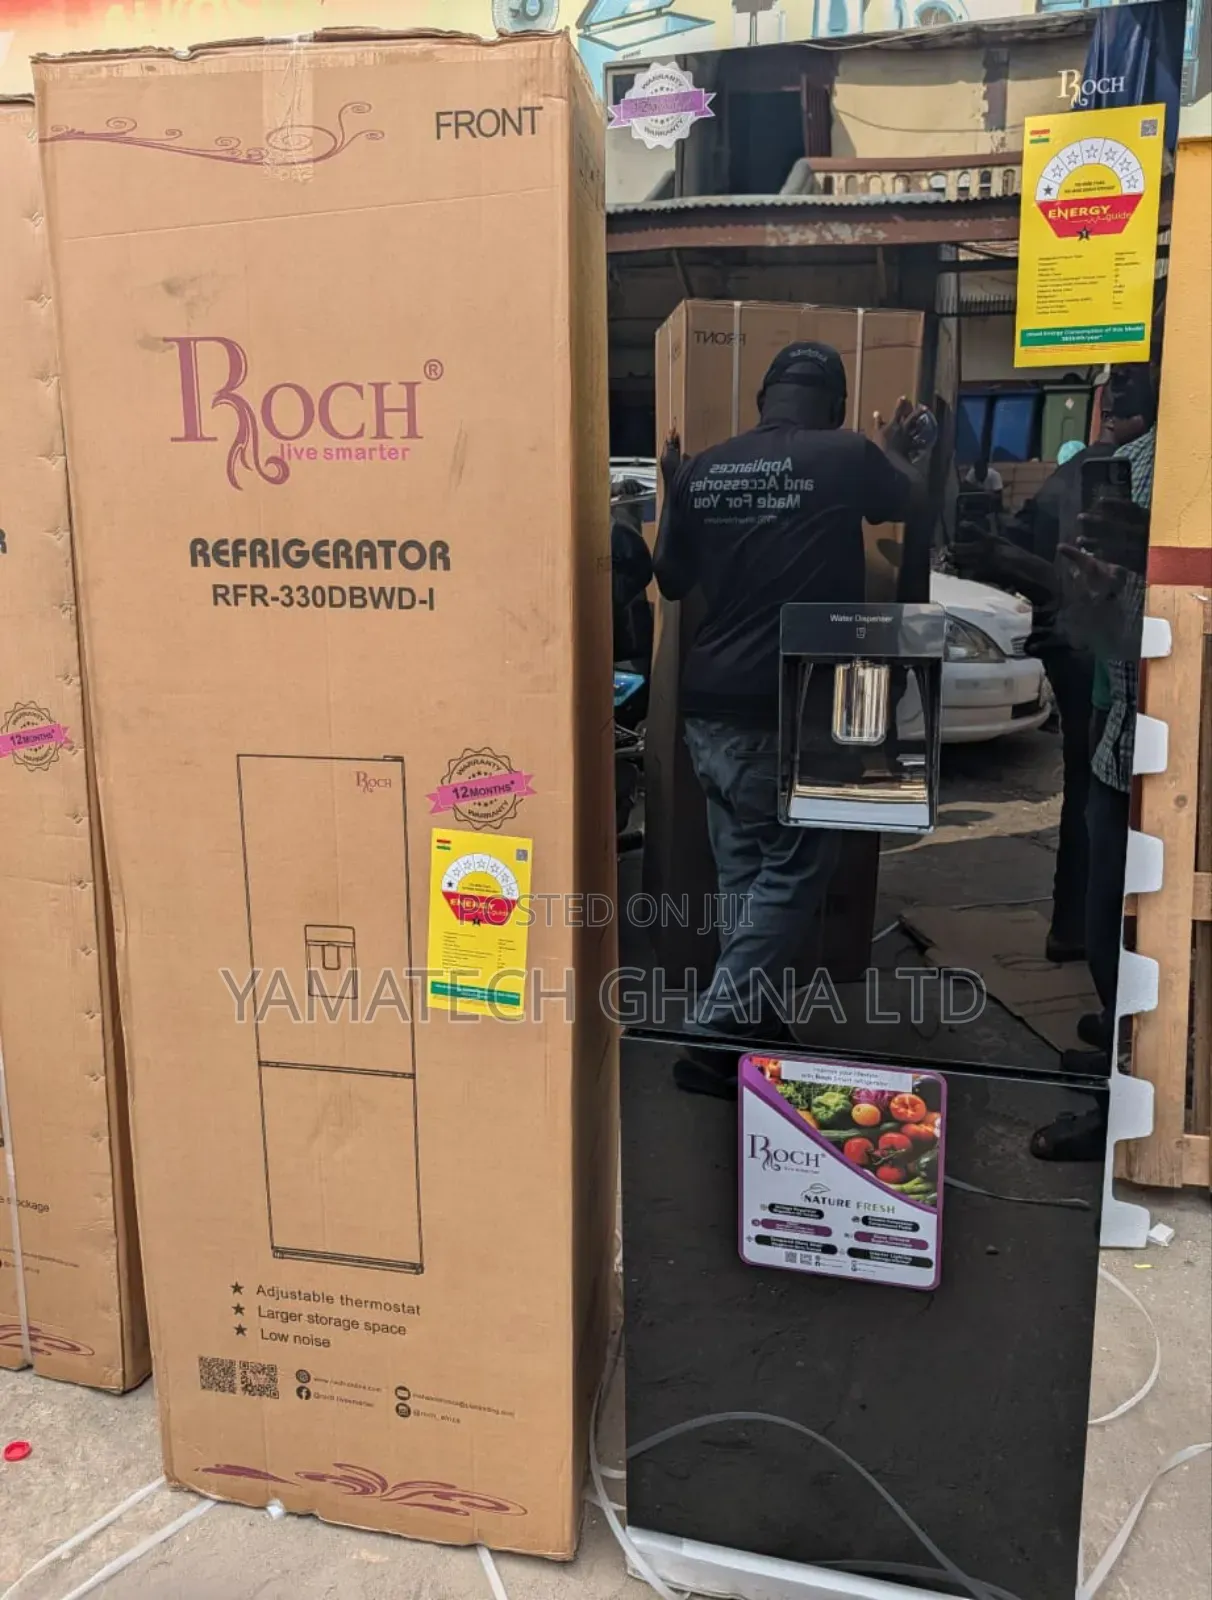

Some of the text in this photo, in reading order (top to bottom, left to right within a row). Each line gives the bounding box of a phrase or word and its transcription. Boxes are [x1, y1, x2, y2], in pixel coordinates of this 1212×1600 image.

[1056, 69, 1125, 109] ROCH
[435, 106, 543, 140] FRONT
[1048, 204, 1111, 220] ENERGY
[162, 336, 425, 491] ROCH
[279, 443, 411, 461] live smarter
[190, 537, 451, 571] REFRIGERATOR
[212, 584, 435, 611] RFR-330DBWD-I
[830, 613, 893, 624] Water Dispenser
[747, 1133, 822, 1172] ROCH
[7, 1196, 50, 1214] sockage
[804, 1194, 895, 1214] NATURE FRESH
[256, 1284, 421, 1316] Adjustable thermostat
[258, 1305, 407, 1336] Larger storage space
[260, 1328, 331, 1348] Low noise
